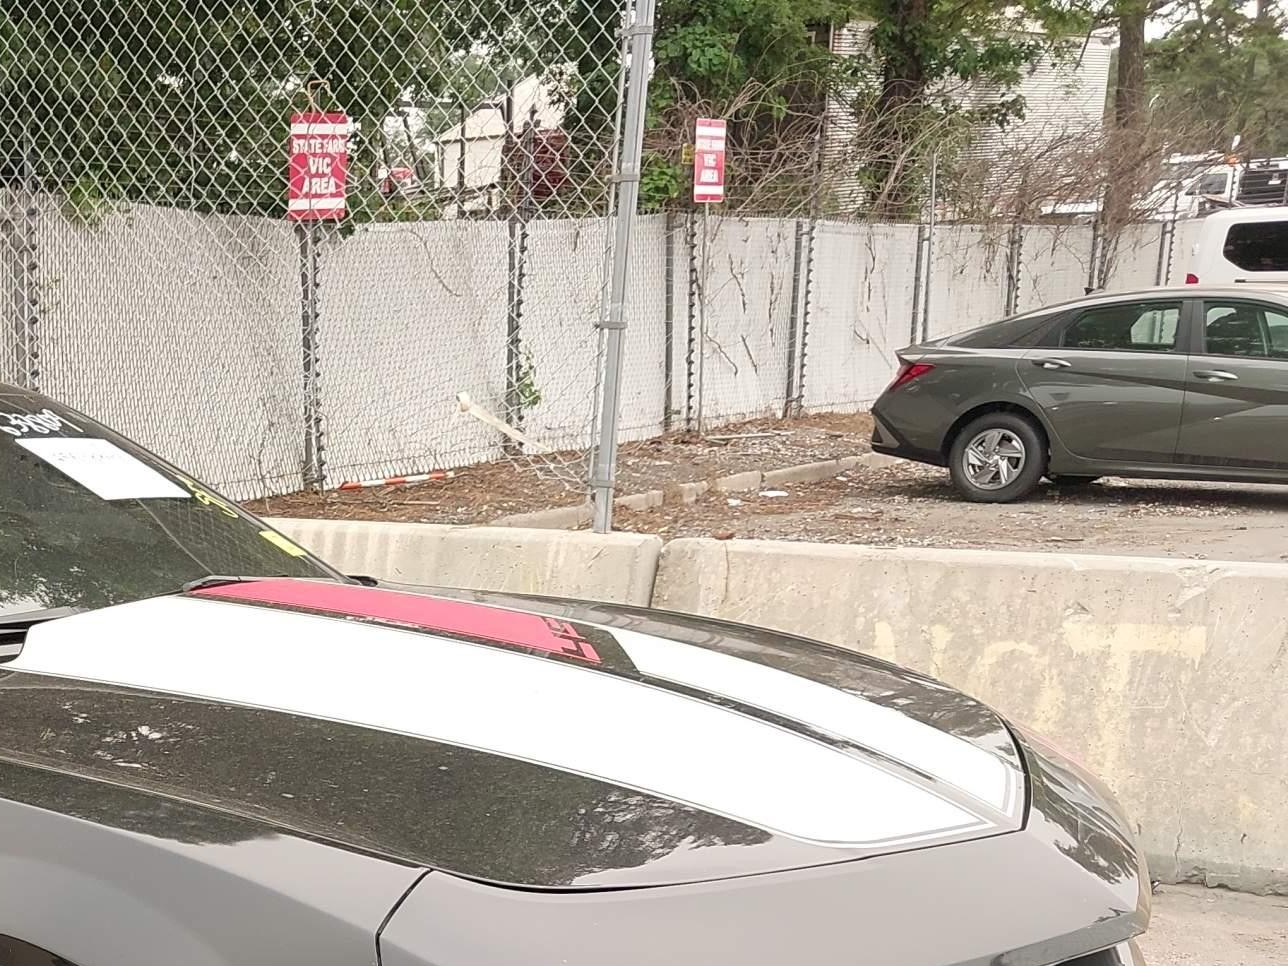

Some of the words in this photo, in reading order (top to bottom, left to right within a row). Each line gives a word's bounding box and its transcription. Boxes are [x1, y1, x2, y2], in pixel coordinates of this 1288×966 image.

[293, 138, 323, 153] STATE
[308, 157, 332, 174] VIC
[302, 177, 336, 194] AREA
